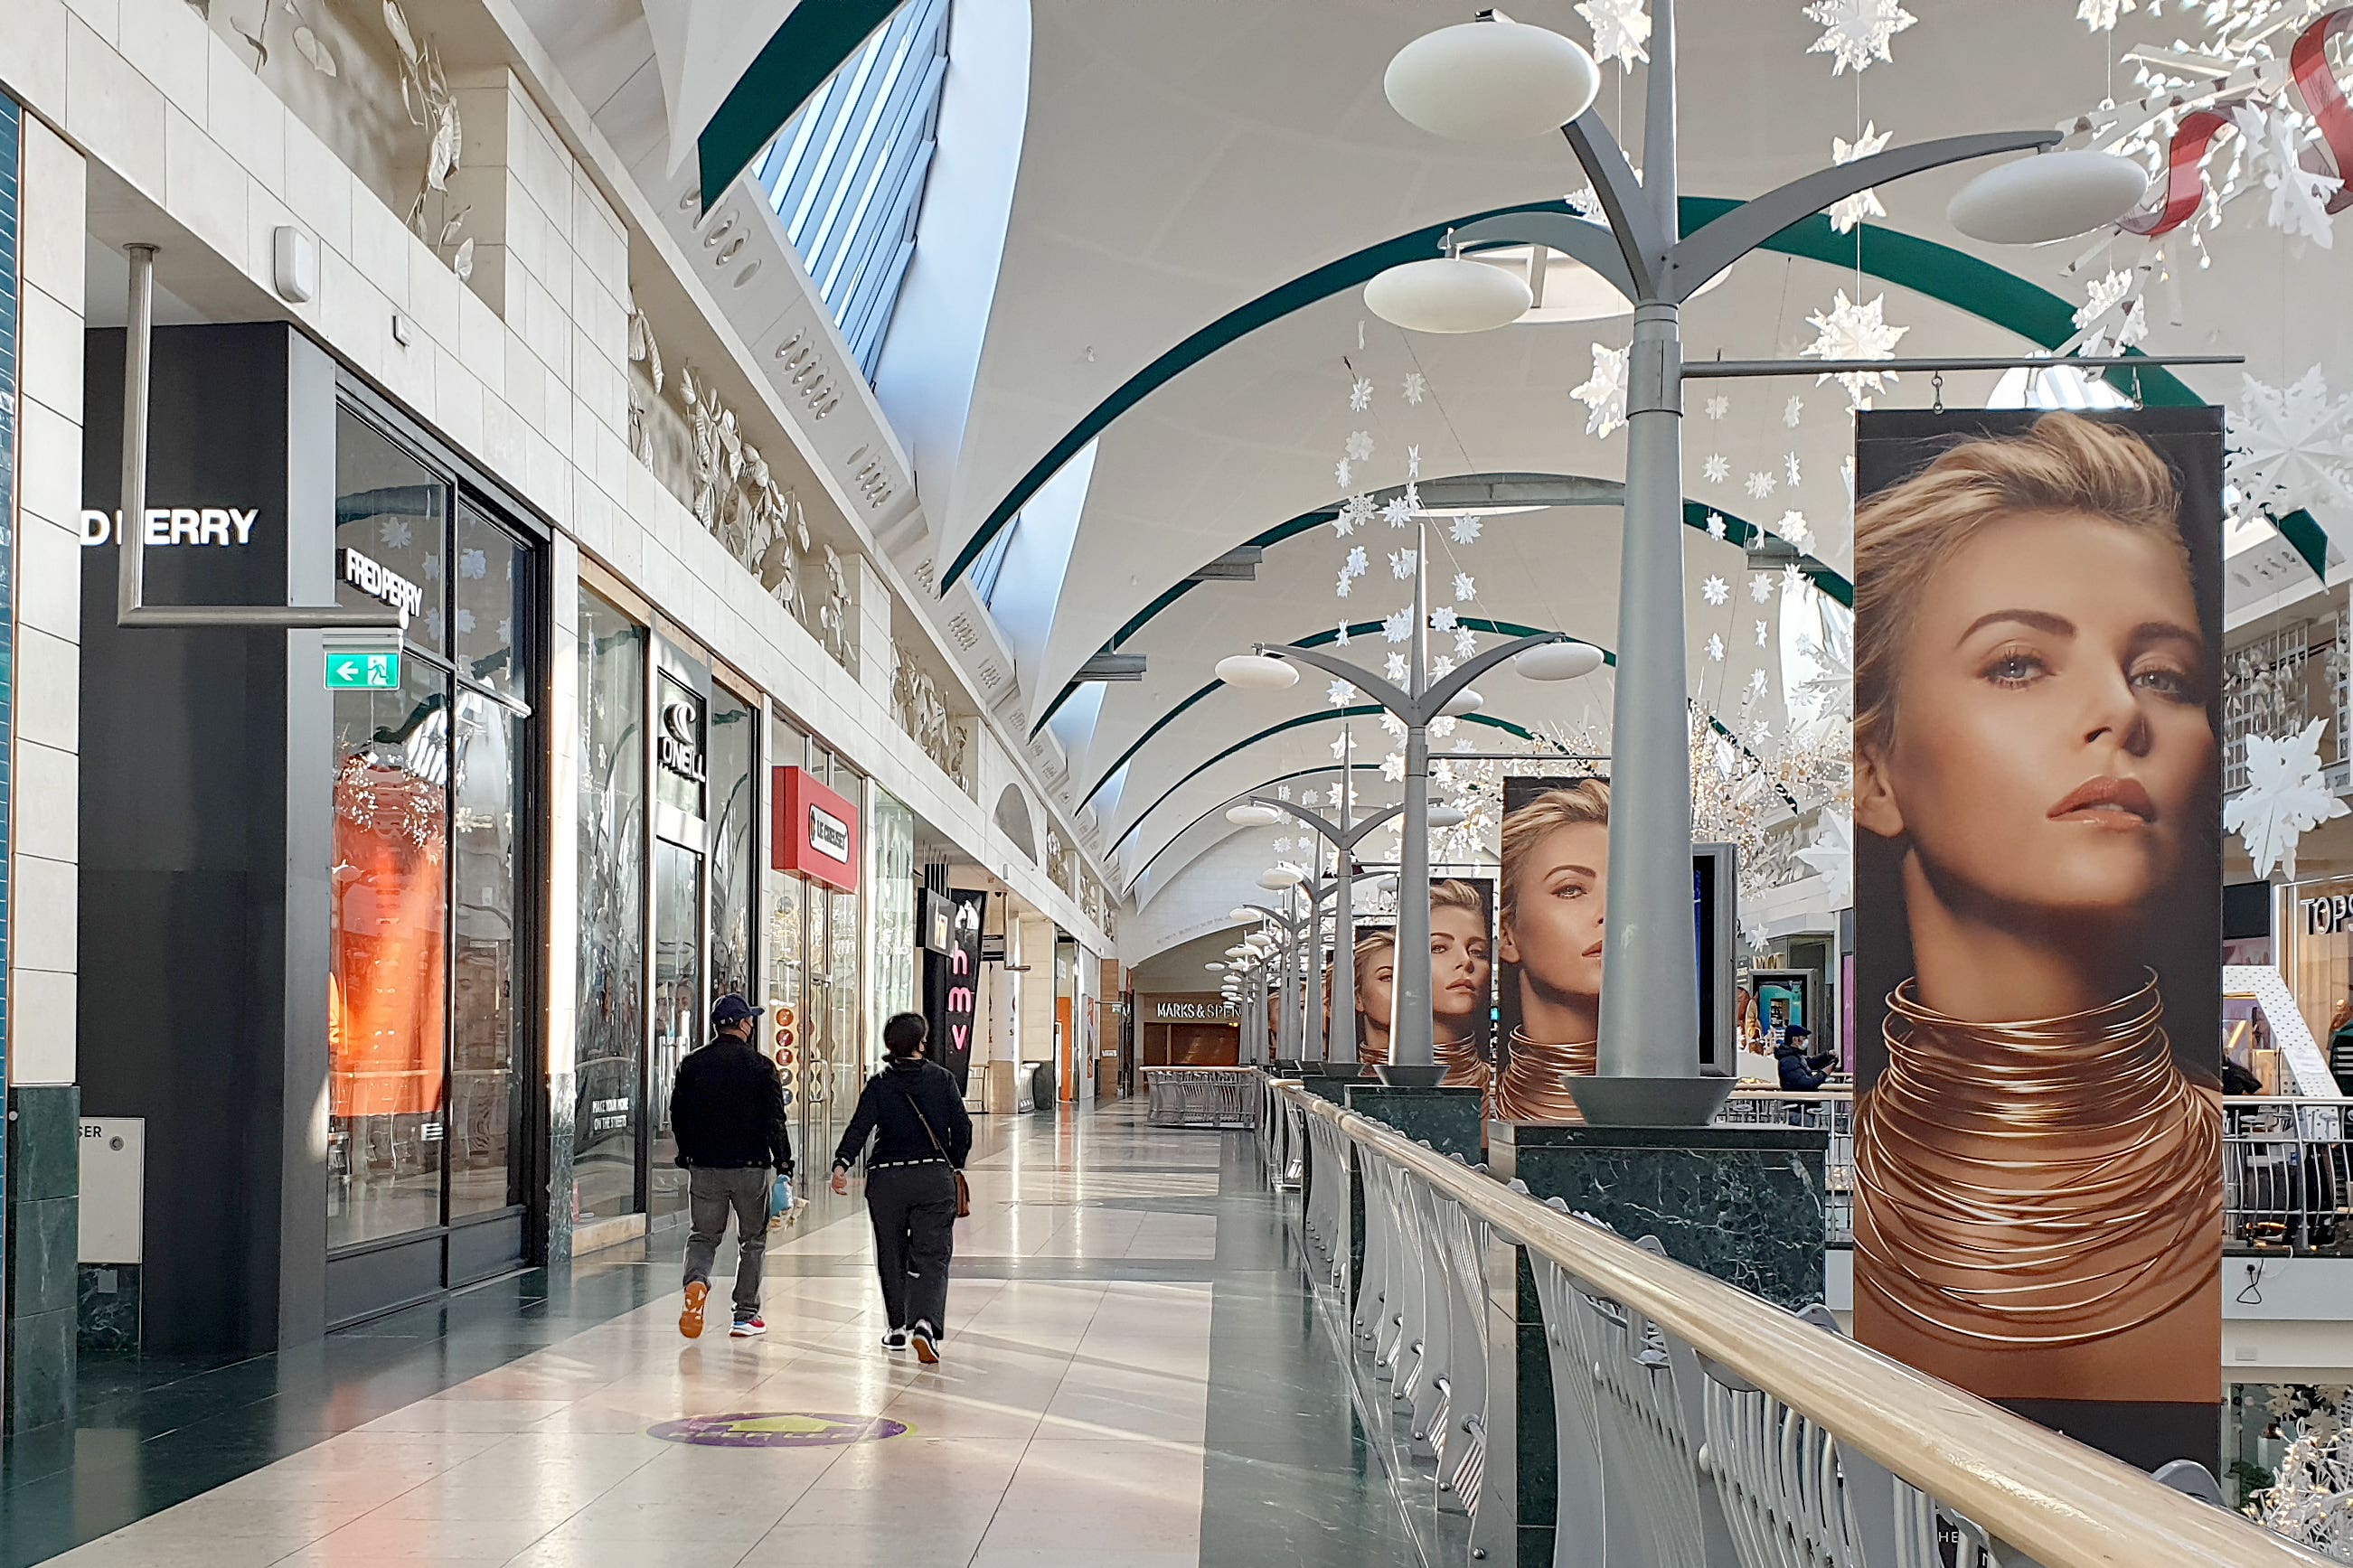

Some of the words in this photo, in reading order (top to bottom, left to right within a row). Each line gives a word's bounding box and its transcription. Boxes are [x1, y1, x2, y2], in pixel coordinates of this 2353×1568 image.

[116, 508, 259, 547] ERRY
[347, 548, 381, 596] FRED
[381, 567, 422, 617] PERRY
[817, 820, 824, 839] LE
[948, 940, 973, 1050] hmv
[1157, 1002, 1195, 1018] MARKS
[1197, 1004, 1205, 1019] &
